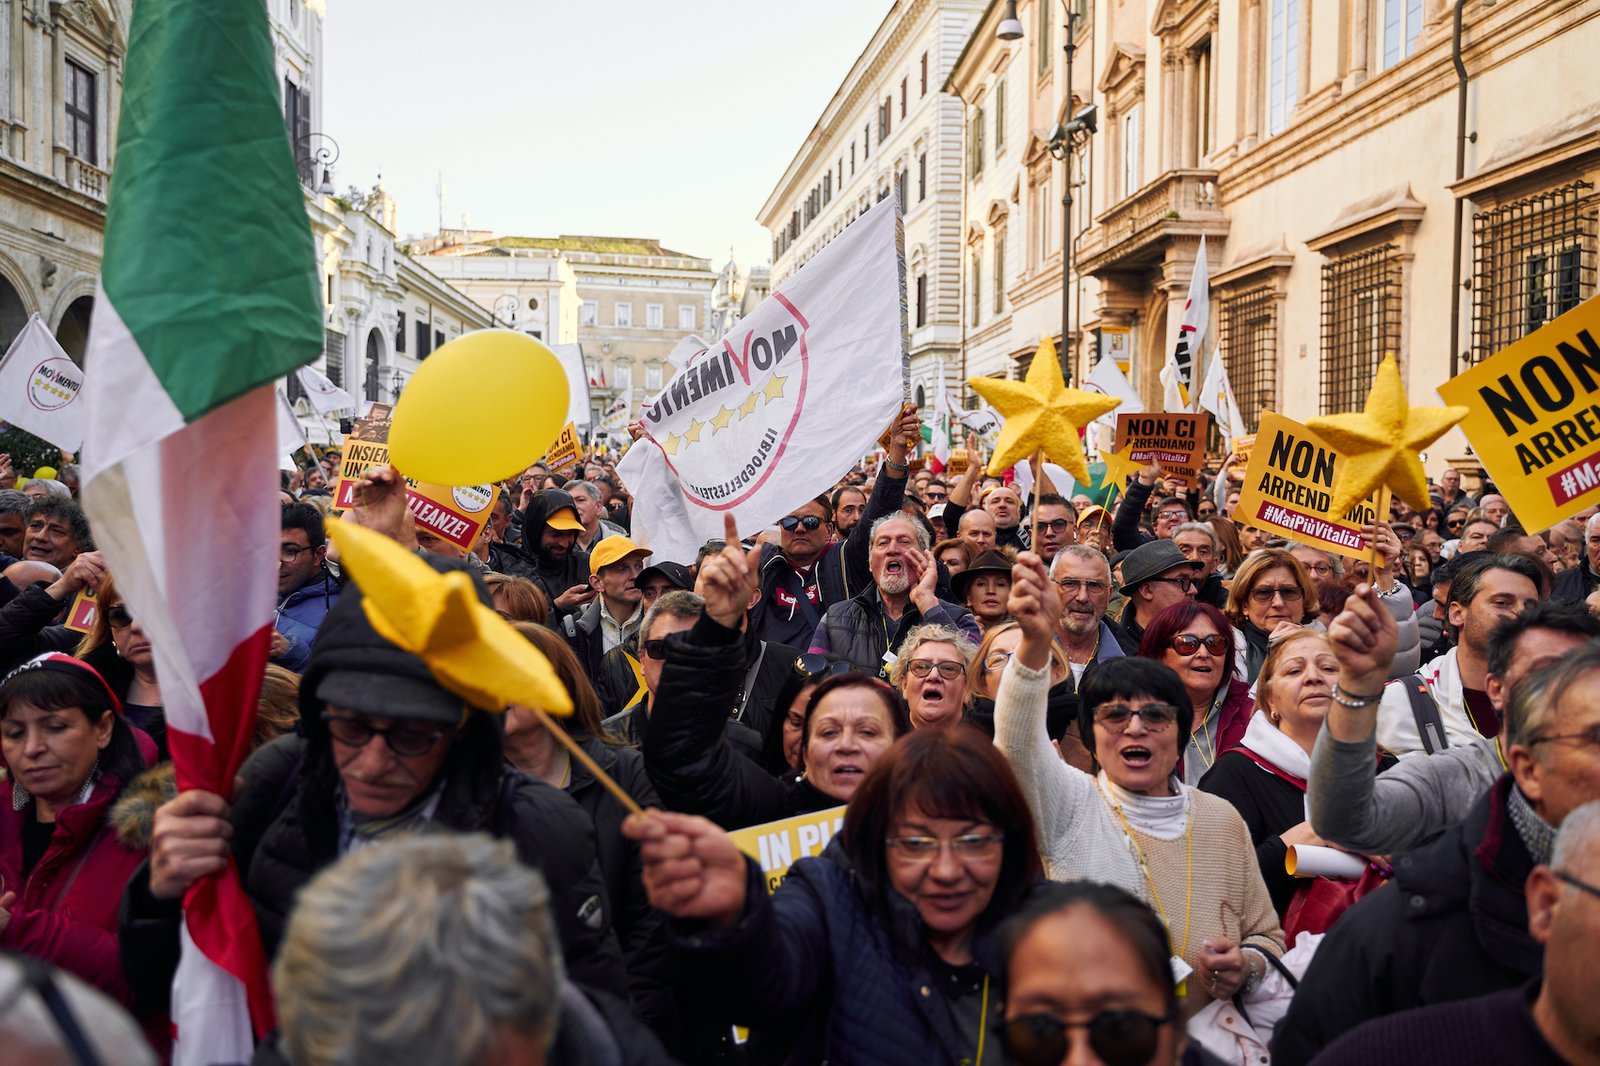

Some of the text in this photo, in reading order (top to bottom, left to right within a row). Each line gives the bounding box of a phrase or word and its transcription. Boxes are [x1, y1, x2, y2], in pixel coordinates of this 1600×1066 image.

[38, 365, 80, 392] MOVIMENTO
[561, 428, 572, 444] CI
[1127, 418, 1196, 438] NON CI
[1514, 404, 1600, 476] ARRE
[1268, 429, 1337, 488] NON
[405, 493, 470, 539] LLEANZE!
[1258, 472, 1376, 525] ARRENDMO
[1263, 504, 1361, 548] #MaiPiùVitalizi
[757, 829, 793, 872] IN
